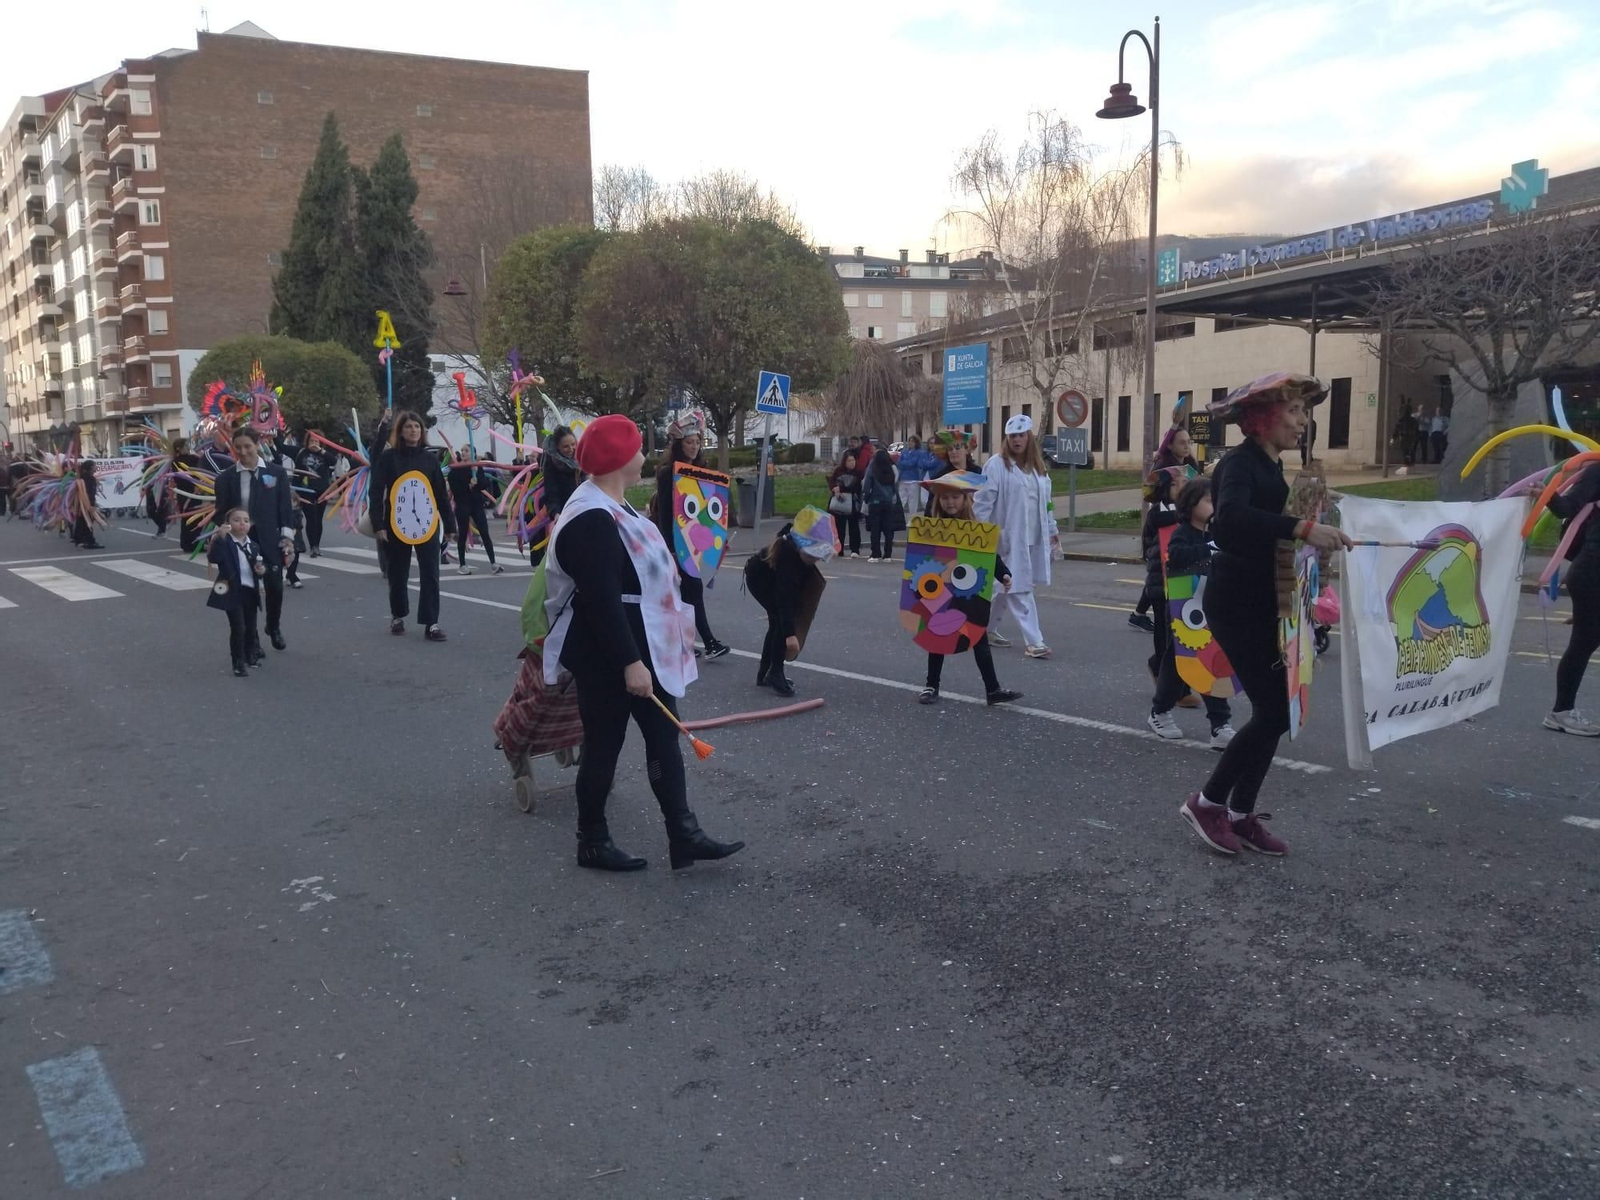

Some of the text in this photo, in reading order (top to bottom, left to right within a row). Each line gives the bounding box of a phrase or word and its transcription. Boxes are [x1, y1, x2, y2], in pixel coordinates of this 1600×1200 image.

[1181, 199, 1494, 281] Hospital Comarcal de Valdeorras
[957, 353, 974, 362] XUNTA
[956, 360, 984, 370] DE GALICIA
[1191, 415, 1210, 423] TAXI
[1060, 438, 1084, 453] TAXI
